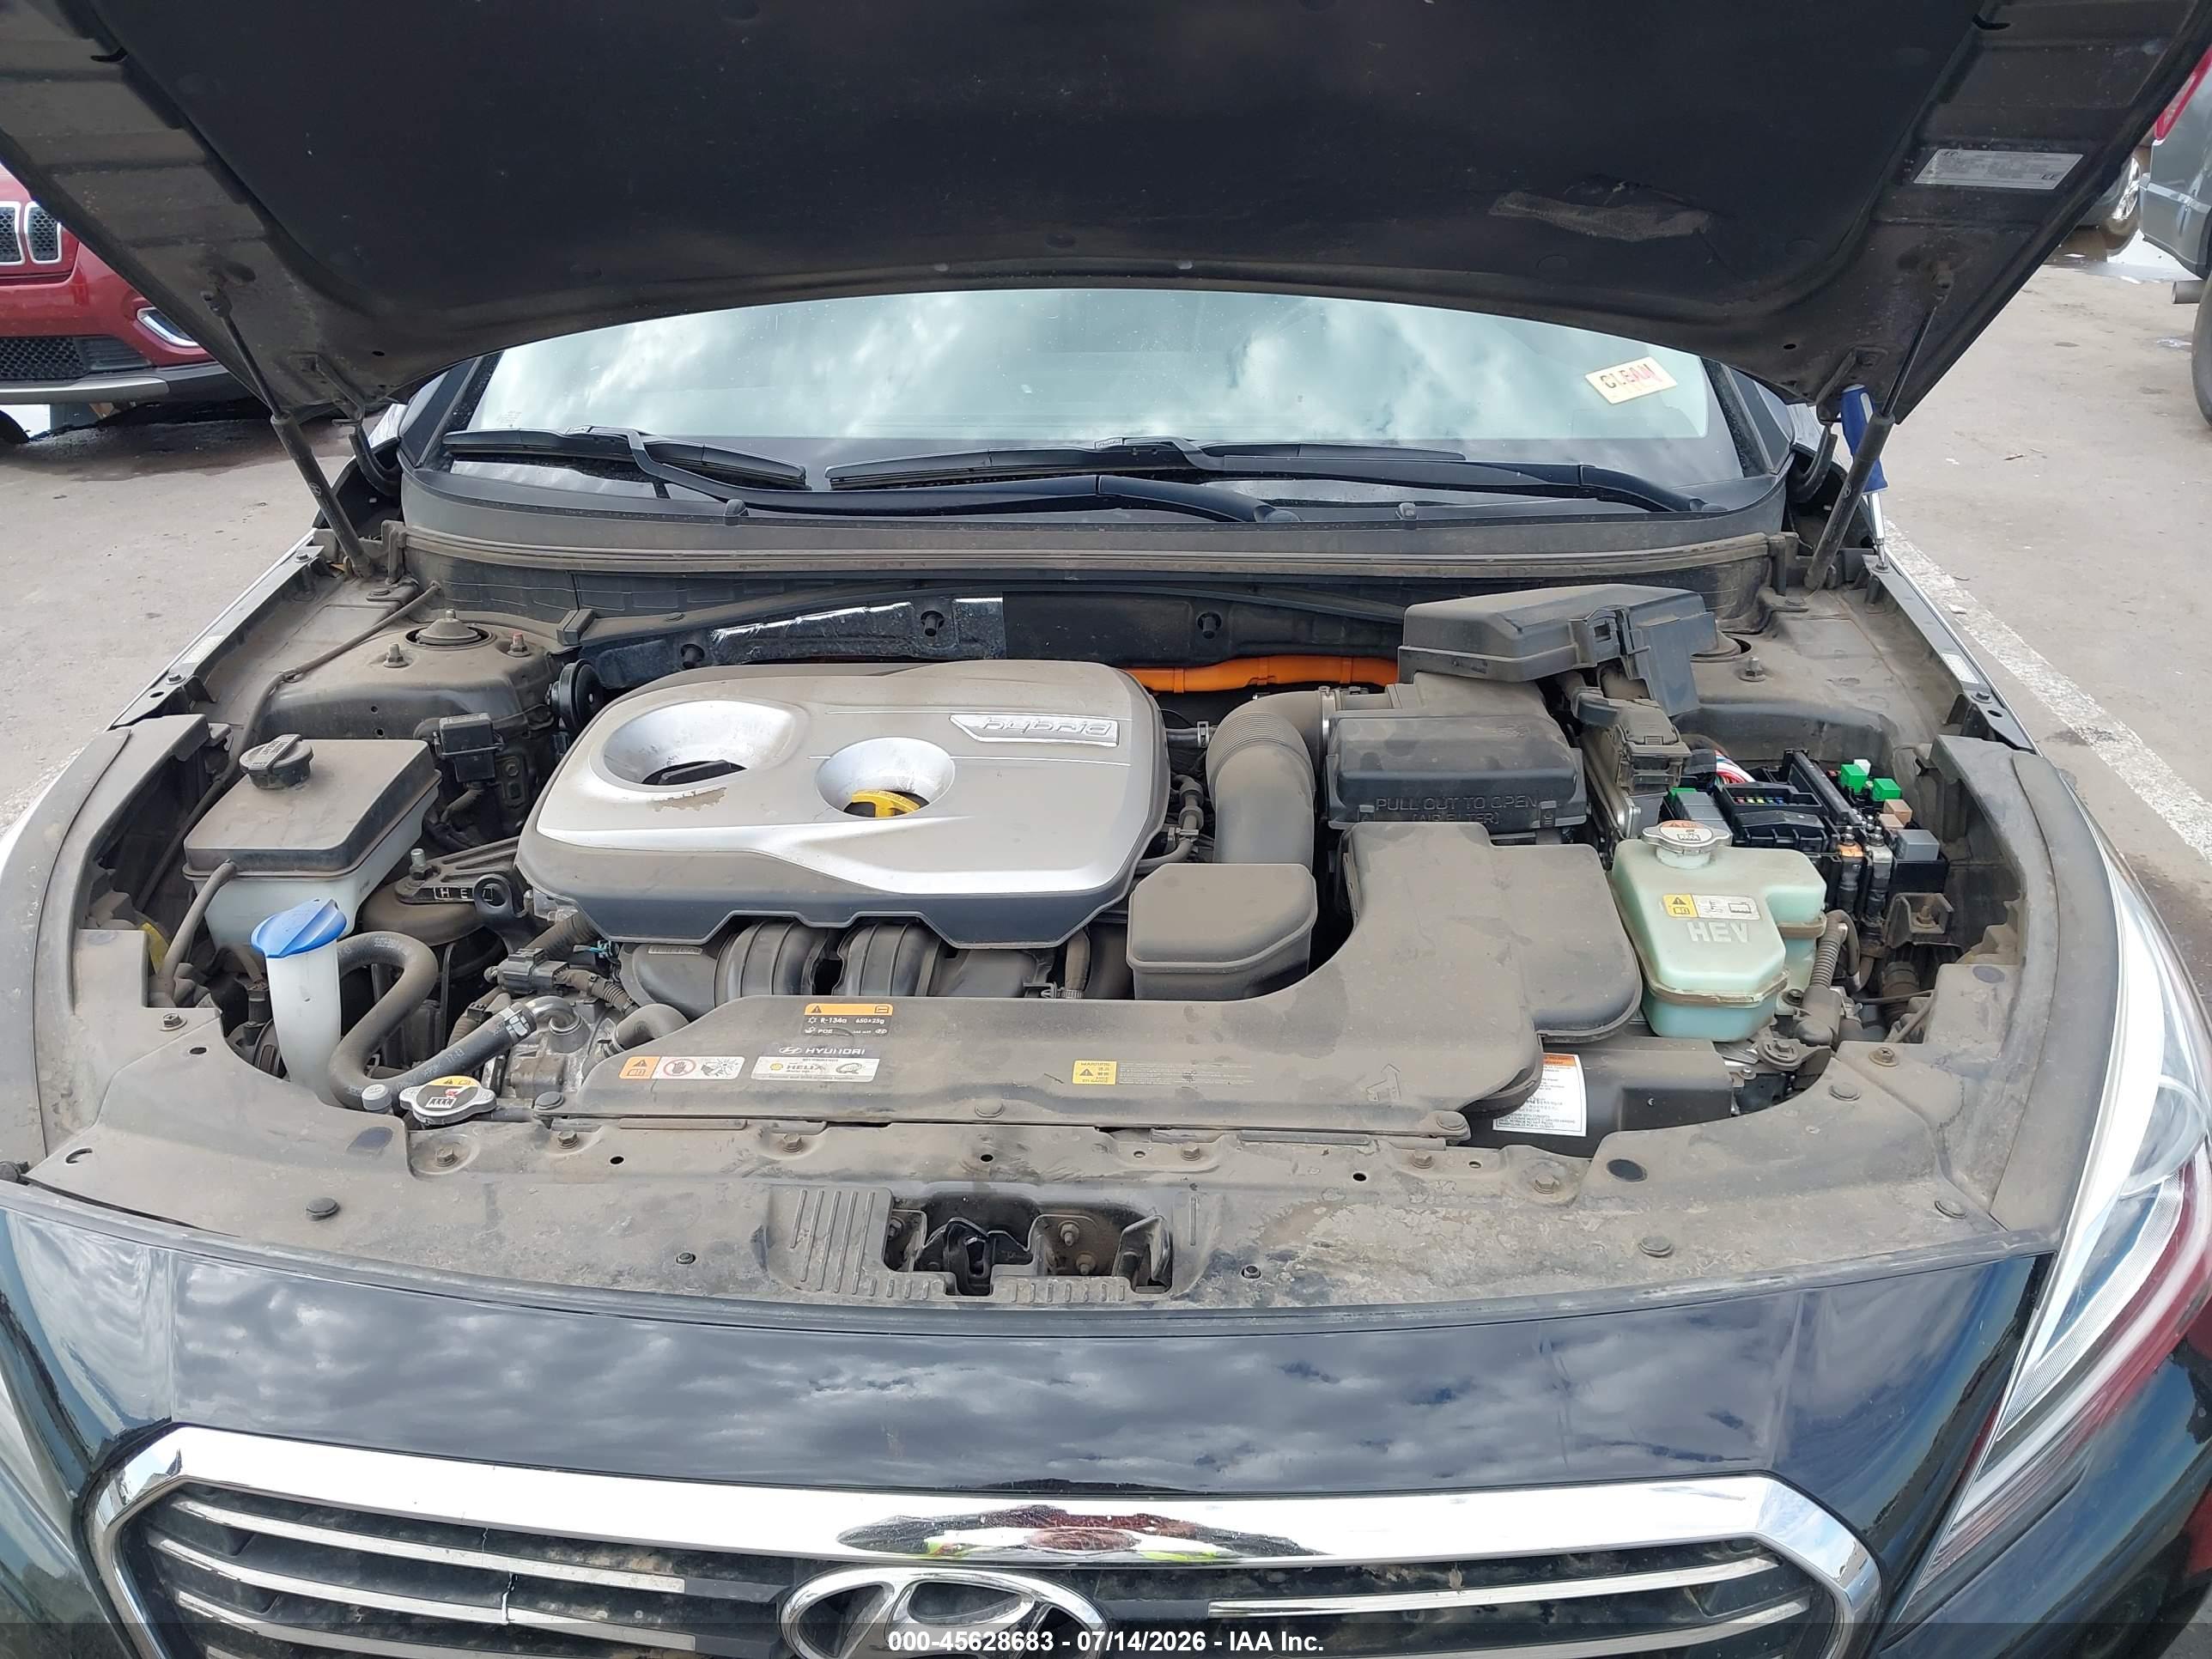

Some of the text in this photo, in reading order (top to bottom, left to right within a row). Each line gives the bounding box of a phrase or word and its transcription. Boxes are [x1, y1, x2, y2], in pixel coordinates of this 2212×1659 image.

[1376, 798, 1419, 811] PULL
[1462, 797, 1486, 809] TO
[1686, 921, 1749, 943] HEV
